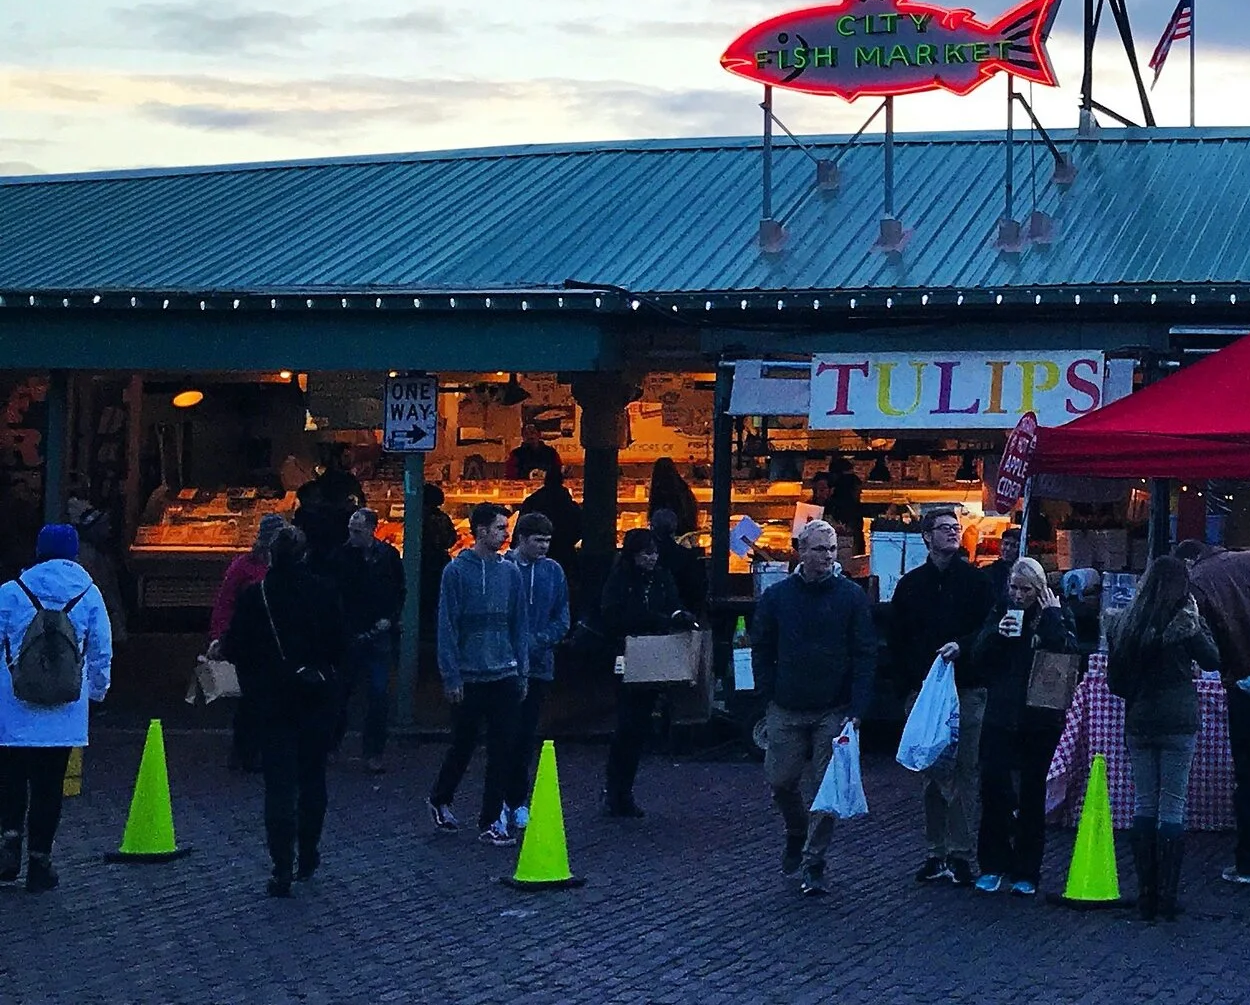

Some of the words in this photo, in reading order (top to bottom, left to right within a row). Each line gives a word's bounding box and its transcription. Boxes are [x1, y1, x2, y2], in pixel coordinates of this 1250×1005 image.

[836, 12, 934, 37] CITY
[755, 46, 836, 70] FISH
[854, 40, 1014, 69] MARKET
[392, 382, 431, 401] ONE
[816, 358, 1101, 416] TULIPS
[391, 403, 433, 421] WAY
